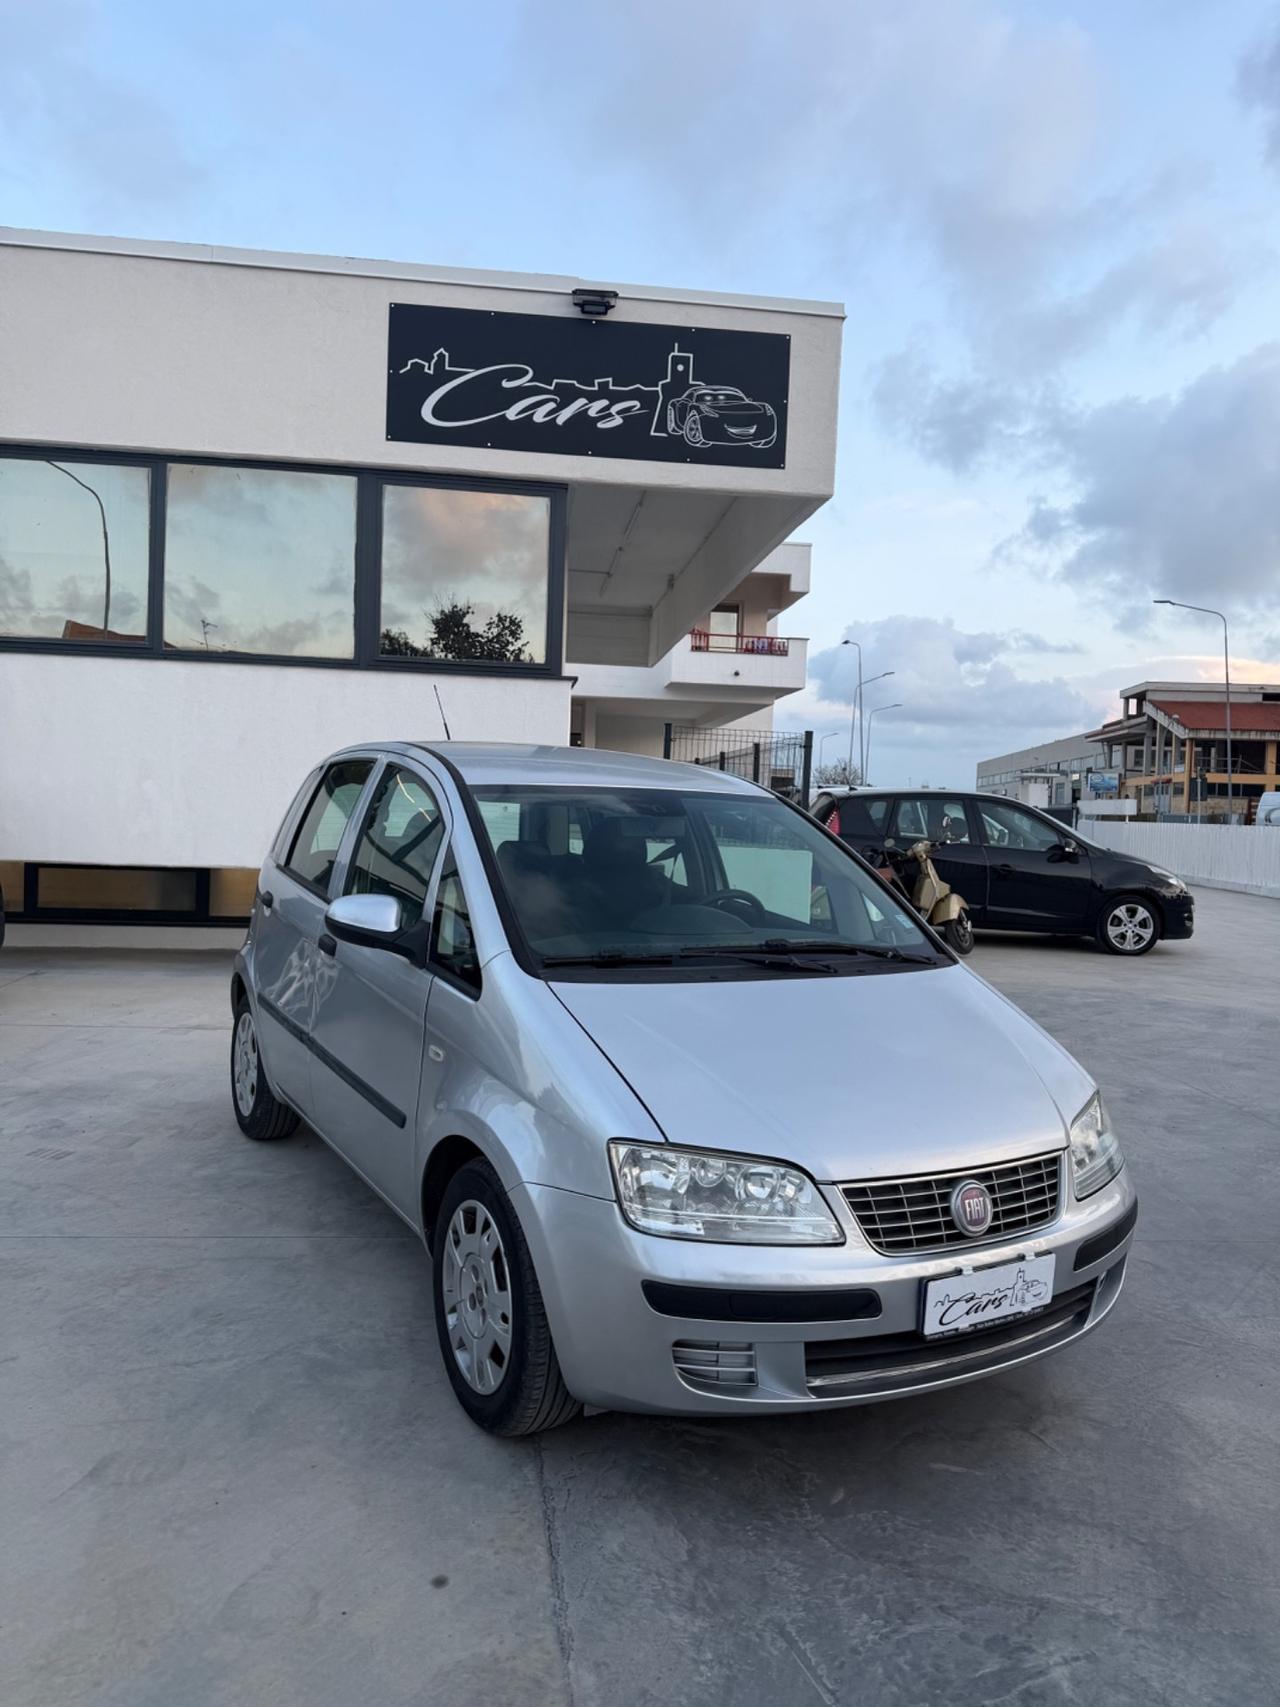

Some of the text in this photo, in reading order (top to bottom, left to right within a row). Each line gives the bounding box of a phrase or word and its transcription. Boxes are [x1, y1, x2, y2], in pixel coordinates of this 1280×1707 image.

[420, 363, 648, 429] Cars
[964, 1197, 986, 1221] FIAT
[940, 1292, 1008, 1326] Cars
